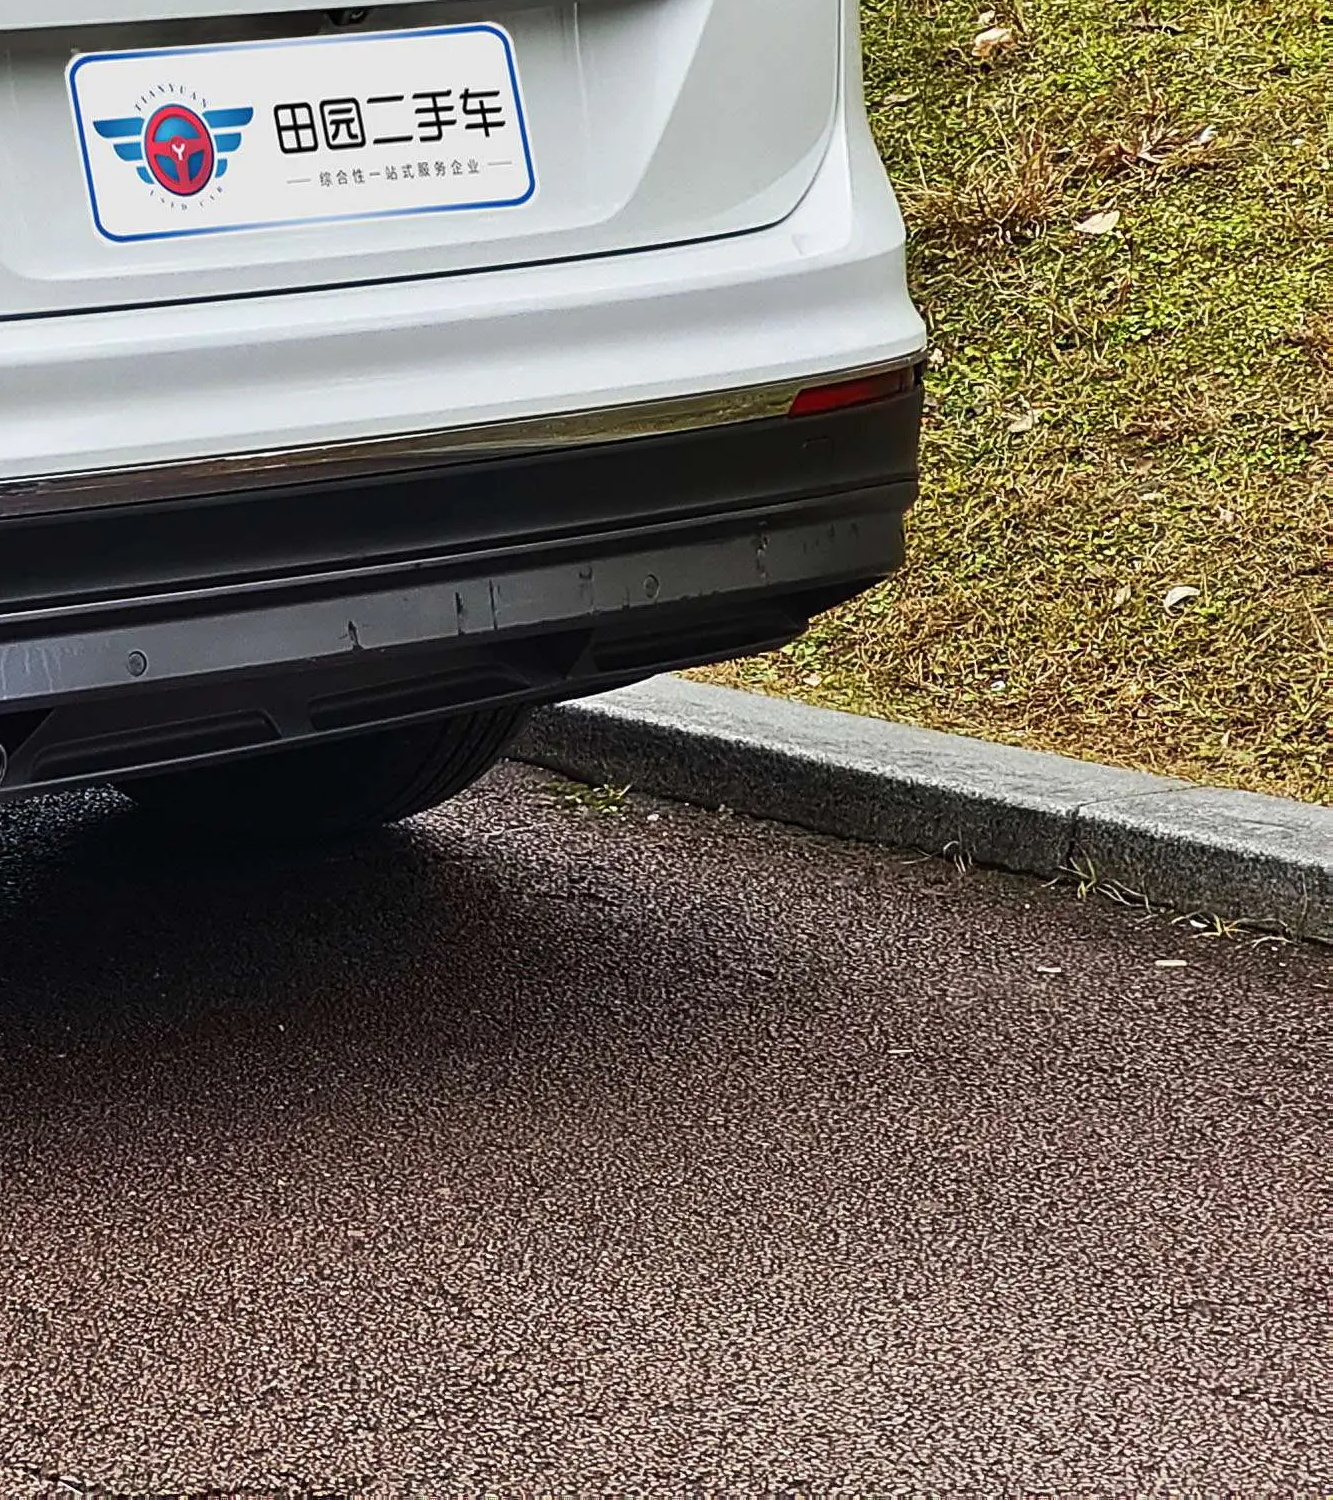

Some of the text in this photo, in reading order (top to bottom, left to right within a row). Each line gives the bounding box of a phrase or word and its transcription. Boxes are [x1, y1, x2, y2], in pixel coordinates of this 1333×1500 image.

[273, 88, 506, 154] 田园二手车
[318, 158, 480, 188] 综合性一站式服务企业
